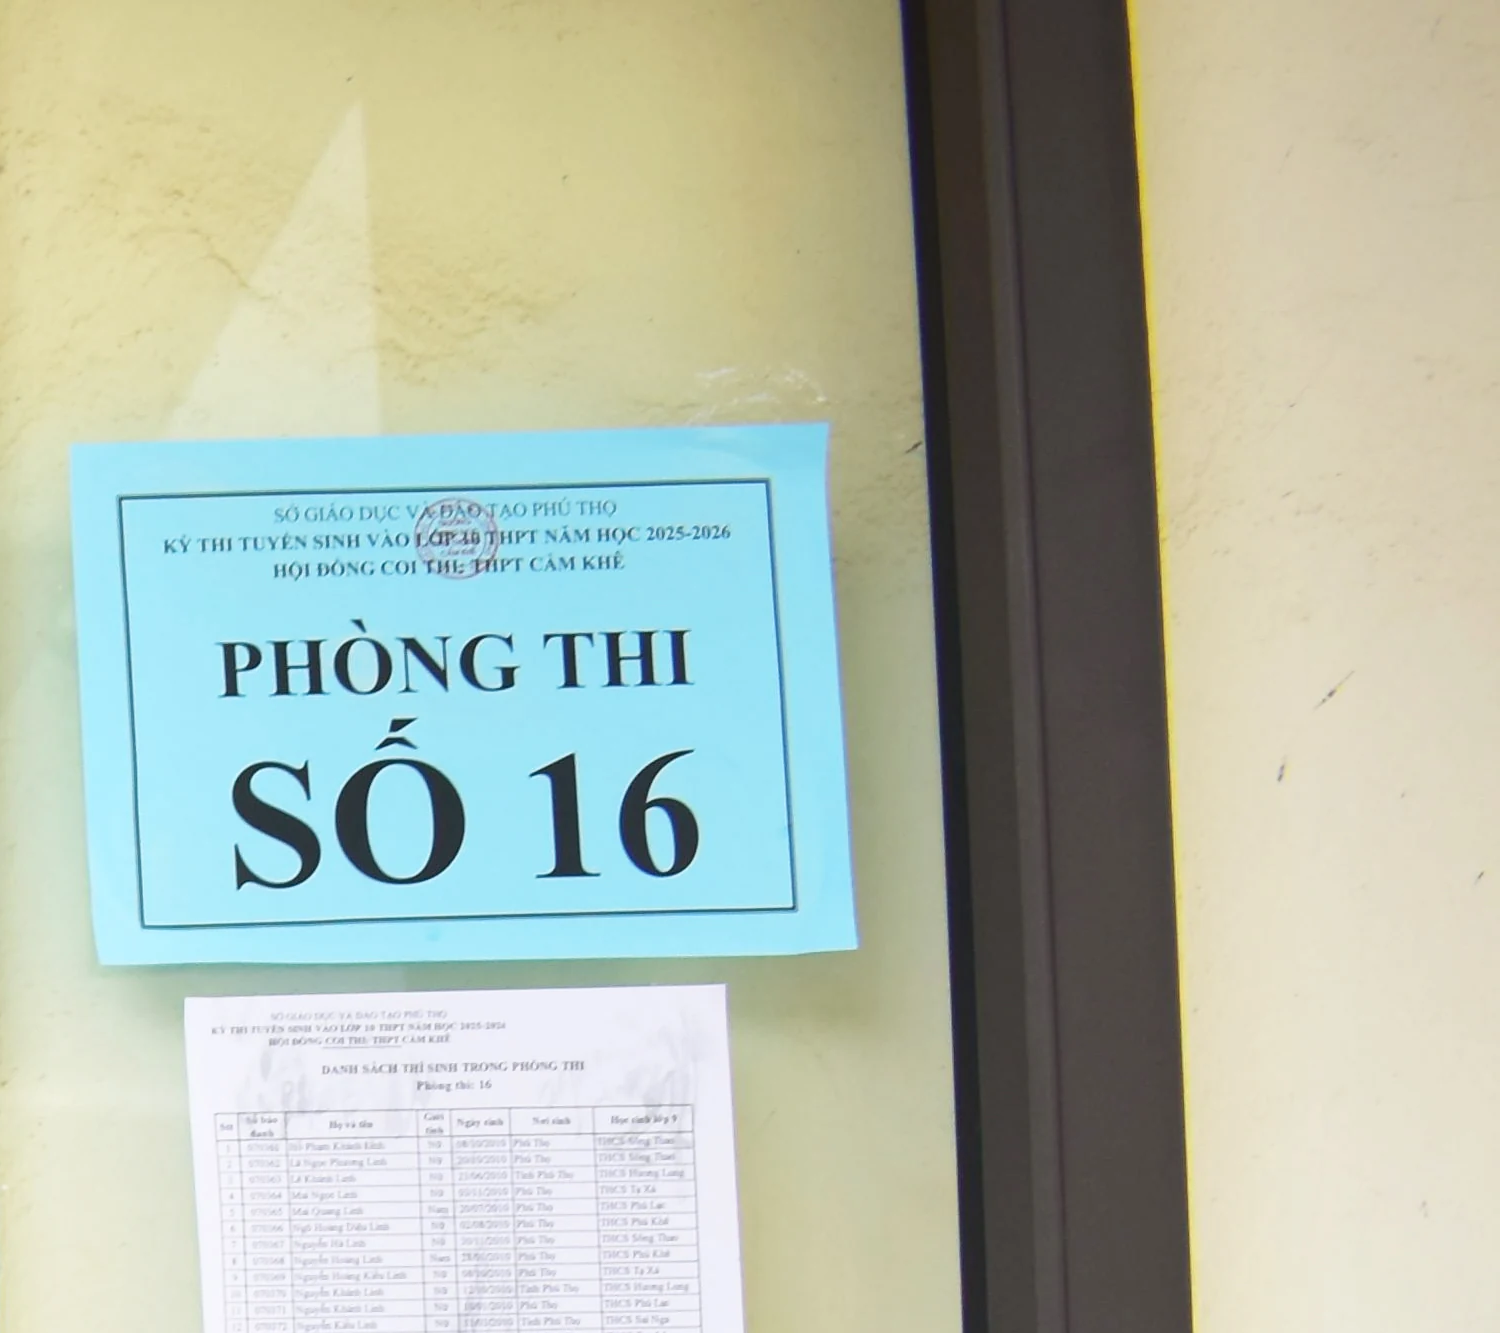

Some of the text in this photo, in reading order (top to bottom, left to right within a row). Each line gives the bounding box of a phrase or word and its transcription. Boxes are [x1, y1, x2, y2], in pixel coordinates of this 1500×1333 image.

[274, 503, 300, 524] SỞ
[304, 502, 354, 522] GIÁO
[359, 505, 400, 523] DỤC
[487, 502, 527, 520] TẠO
[532, 497, 571, 517] PHÚ
[576, 499, 617, 517] THỌ
[164, 535, 191, 554] KỲ
[197, 537, 232, 553] THI
[238, 533, 307, 552] TUYỂN
[313, 534, 360, 550] SINH
[367, 531, 410, 548] VÀO
[485, 530, 537, 545] THPT
[545, 527, 590, 544] NĂM
[597, 527, 640, 545] HỌC
[646, 525, 731, 541] 2025-2026
[274, 561, 310, 581] HỘI
[317, 559, 375, 577] ĐỒNG
[381, 557, 420, 575] COI
[472, 558, 523, 573] THPT
[529, 554, 575, 572] CẨM
[582, 552, 624, 570] KHÊ
[216, 619, 695, 697] PHÒNG THI
[233, 718, 698, 889] SỐ 16
[322, 1060, 584, 1075] DANH SÁCH THÍ SINH TRONG PHÒNG THI
[417, 1079, 492, 1092] Phòng thi: 16
